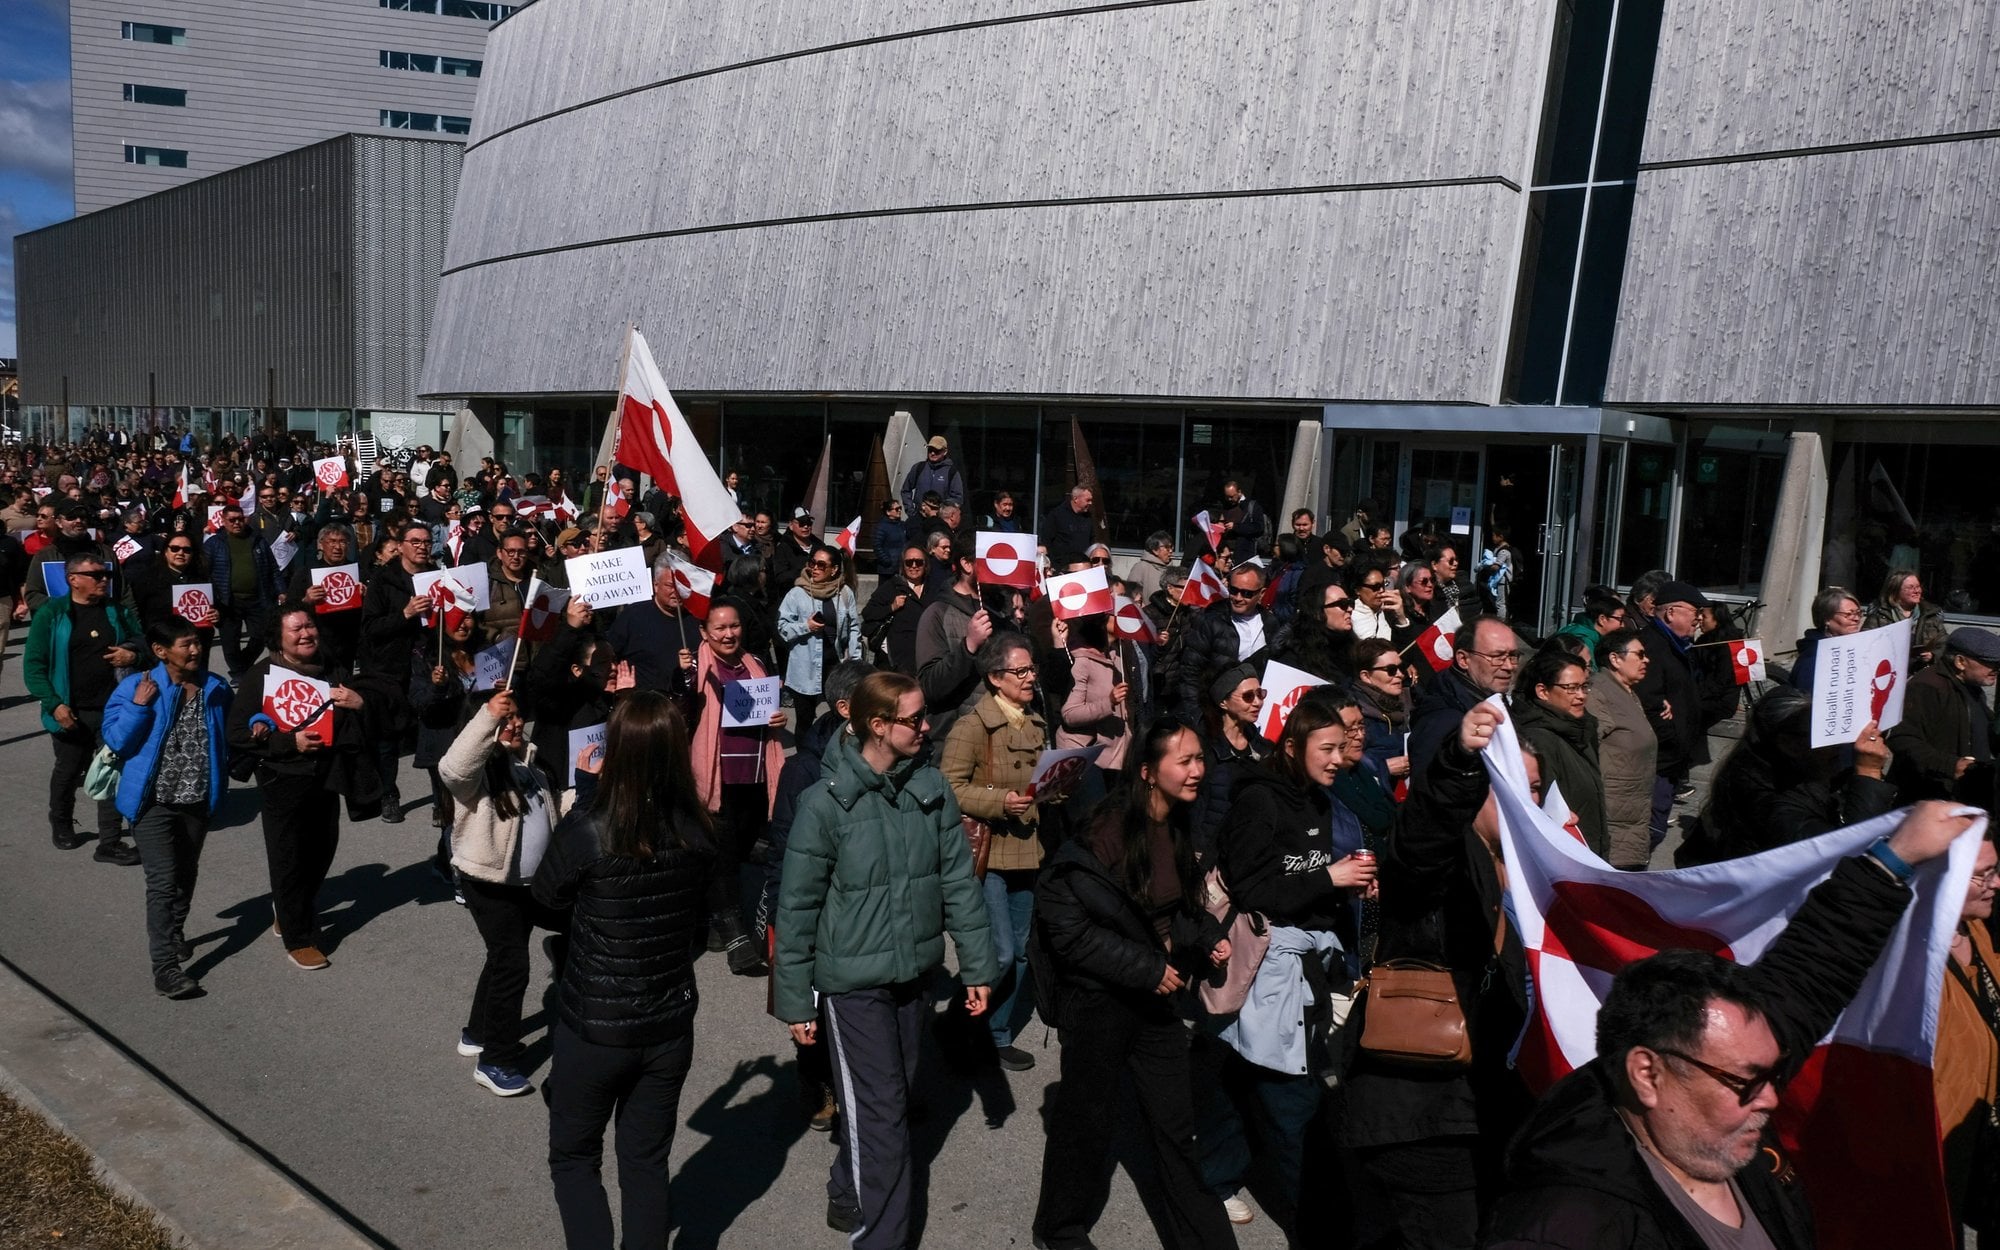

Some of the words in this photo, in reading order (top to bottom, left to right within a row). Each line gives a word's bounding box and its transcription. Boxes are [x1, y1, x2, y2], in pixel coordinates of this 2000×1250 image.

[590, 557, 623, 571] MAKE
[322, 573, 353, 590] USA
[585, 571, 635, 588] AMERICA
[180, 590, 208, 606] USA
[324, 588, 352, 604] ASU
[583, 592, 599, 604] GO
[602, 585, 642, 600] AWAY!!
[181, 605, 208, 620] ASU
[484, 662, 498, 673] NOT
[1829, 646, 1841, 687] nunaat
[1844, 648, 1857, 685] pigaat
[281, 680, 322, 706] USA
[740, 686, 752, 694] WE
[755, 684, 770, 693] ARE
[735, 698, 754, 707] NOT
[756, 697, 772, 705] FOR
[740, 711, 762, 719] SALE
[1825, 690, 1838, 737] Kalaallit
[1841, 688, 1854, 734] Kalaallit
